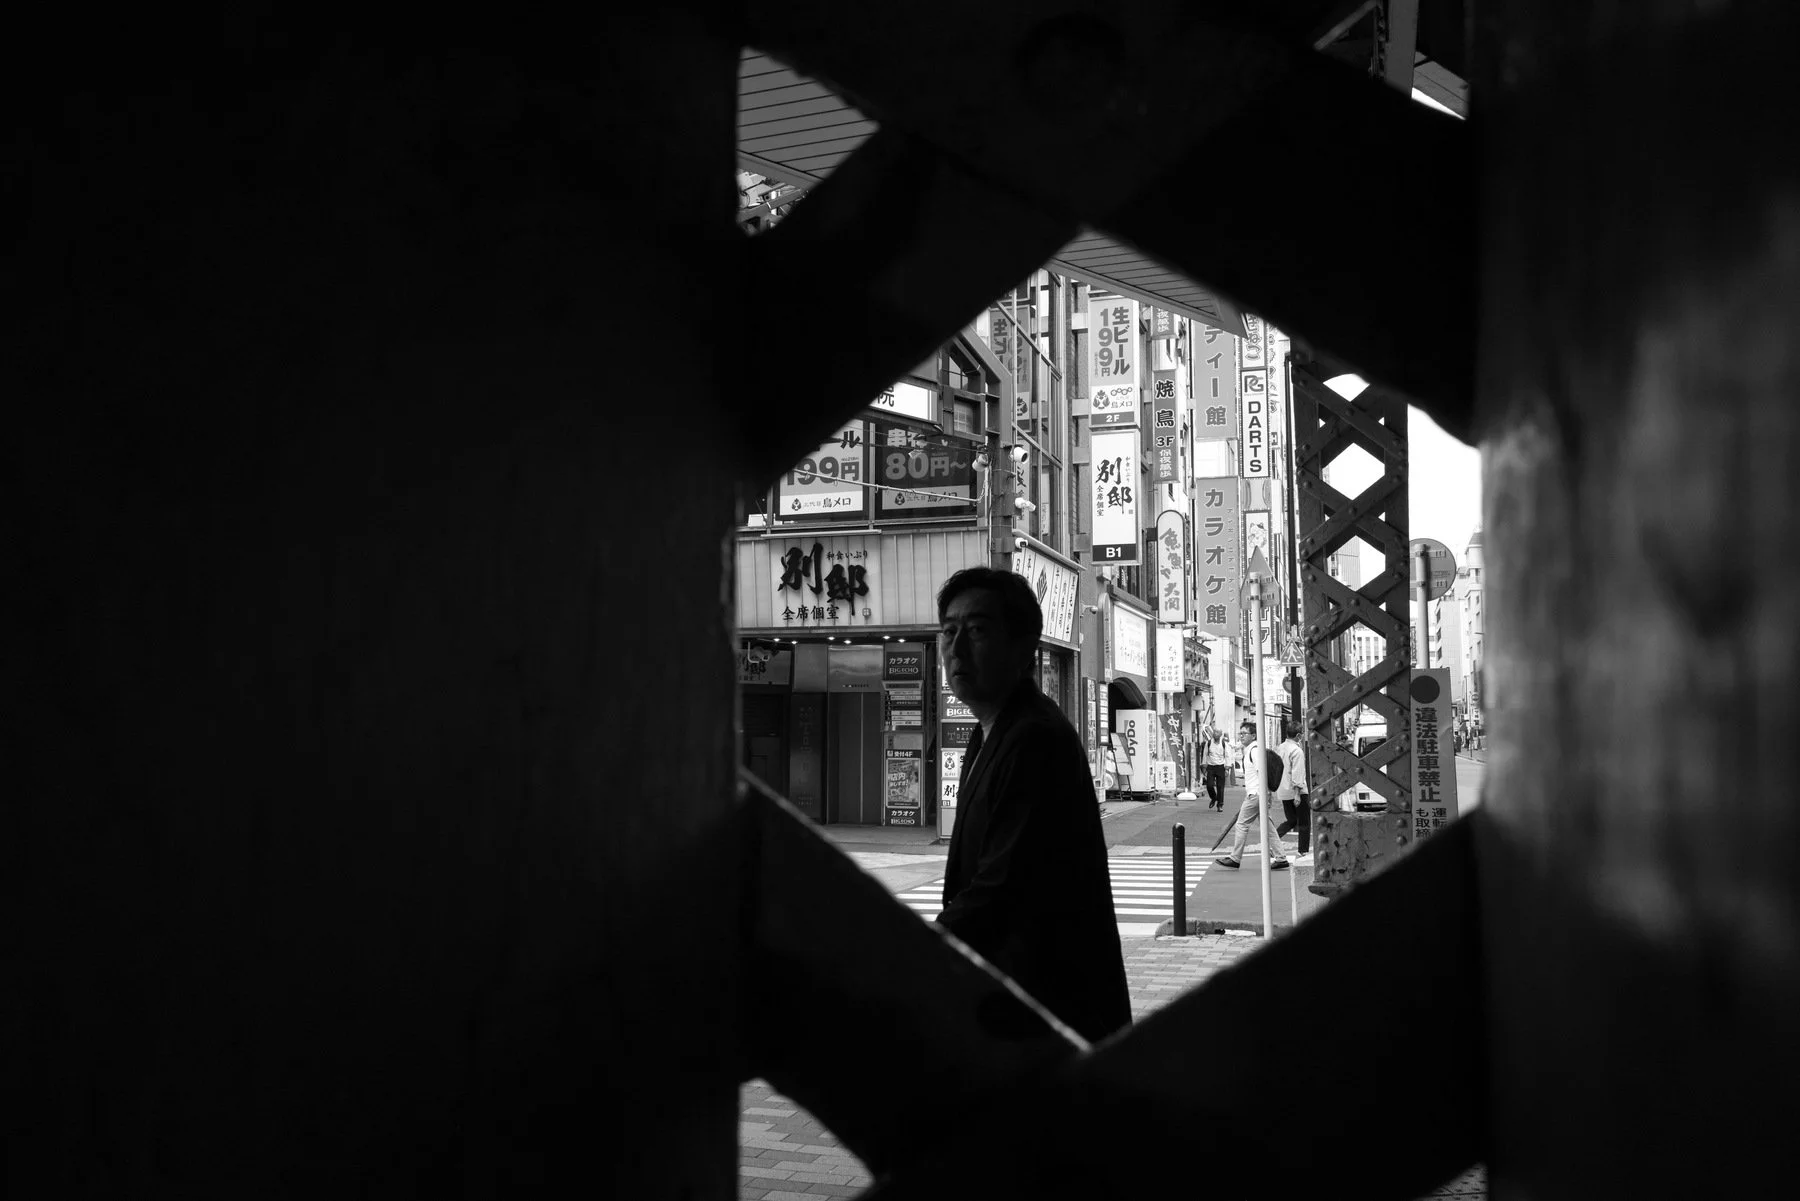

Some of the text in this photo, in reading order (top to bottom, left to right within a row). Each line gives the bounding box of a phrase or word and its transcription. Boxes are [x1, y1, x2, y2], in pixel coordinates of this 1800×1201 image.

[1098, 308, 1113, 377] 199円
[1112, 307, 1130, 375] 生ビール
[1106, 414, 1120, 422] 2F
[1156, 380, 1174, 427] 焼鳥
[1156, 437, 1174, 447] 3F
[1248, 401, 1263, 473] DARTS
[1095, 456, 1133, 514] 別邸
[1106, 547, 1121, 558] B1
[1205, 489, 1227, 625] カラオケ館
[777, 542, 869, 617] 別邸
[781, 604, 840, 621] 全席個室
[889, 657, 918, 665] カラオケ
[1127, 720, 1138, 756] DyDo
[1415, 707, 1442, 802] 違法駐車禁止
